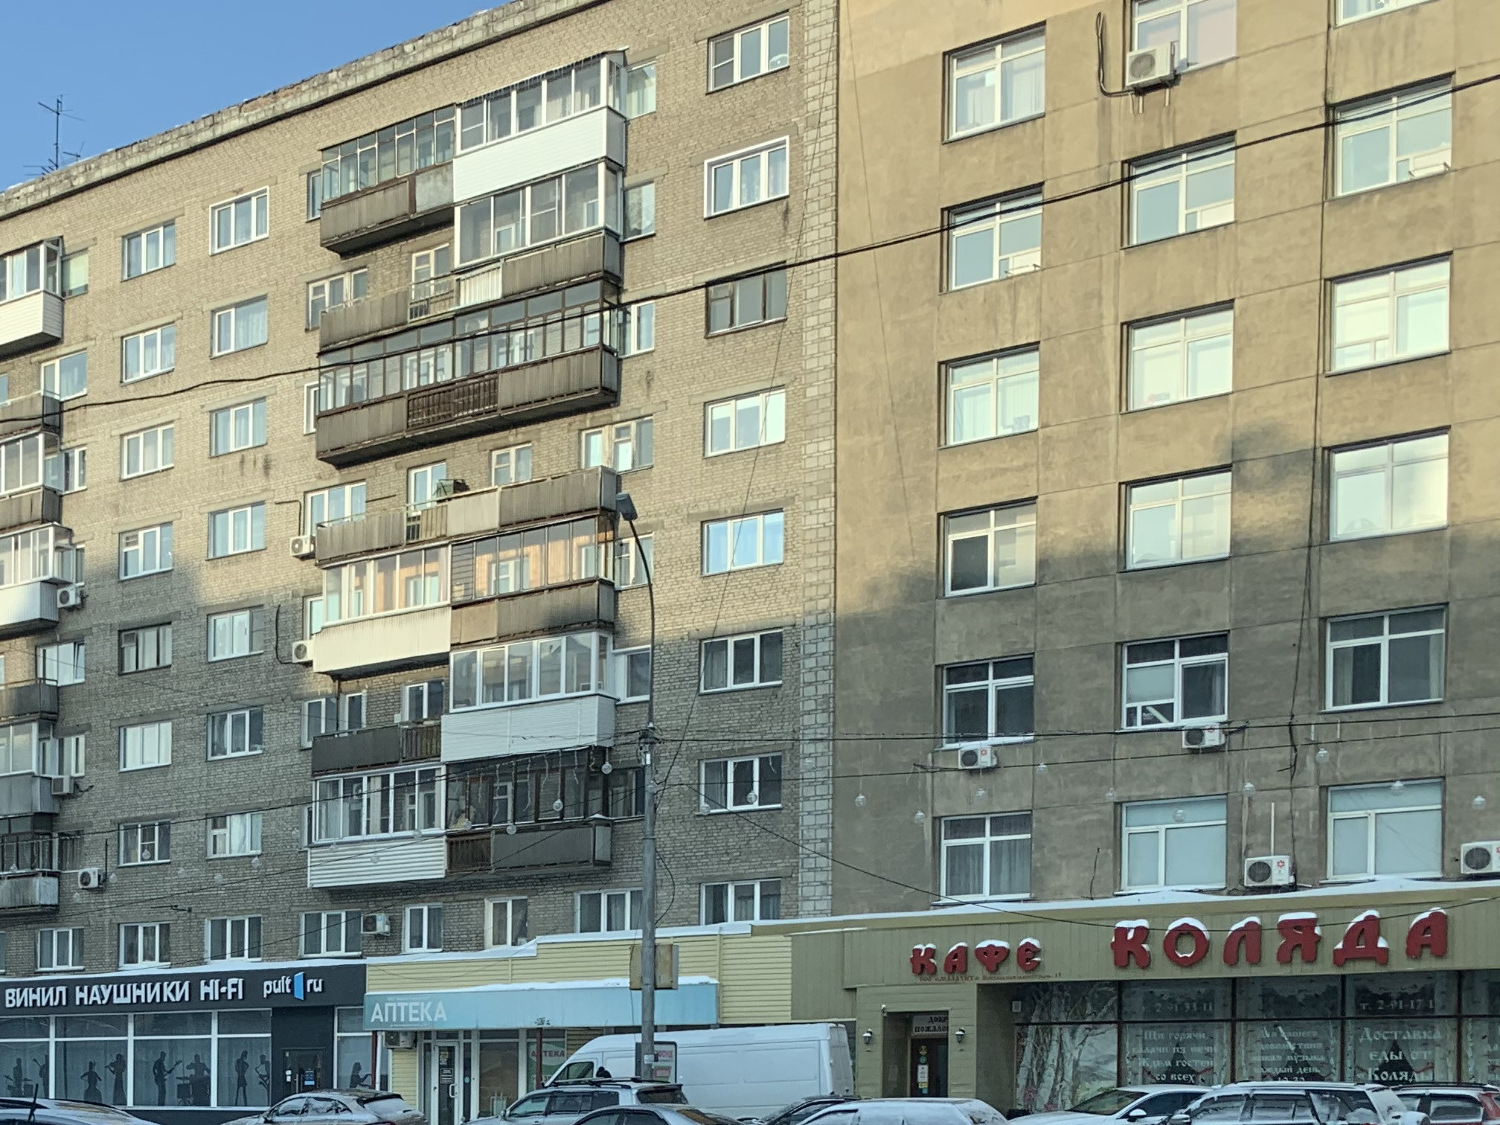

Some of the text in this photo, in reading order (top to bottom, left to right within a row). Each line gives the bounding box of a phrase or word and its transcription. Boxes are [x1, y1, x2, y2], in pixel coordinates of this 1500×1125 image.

[910, 908, 1448, 975] КАФЕ КОЛЯДА
[5, 978, 244, 1008] ВИНИЛ НАУШНИКИ HI-FI
[370, 1001, 447, 1023] АПТЕКА
[1359, 1027, 1441, 1042] Доставка
[531, 1049, 565, 1058] АТЕКА
[1369, 1050, 1402, 1063] еды
[1170, 1073, 1195, 1083] всех
